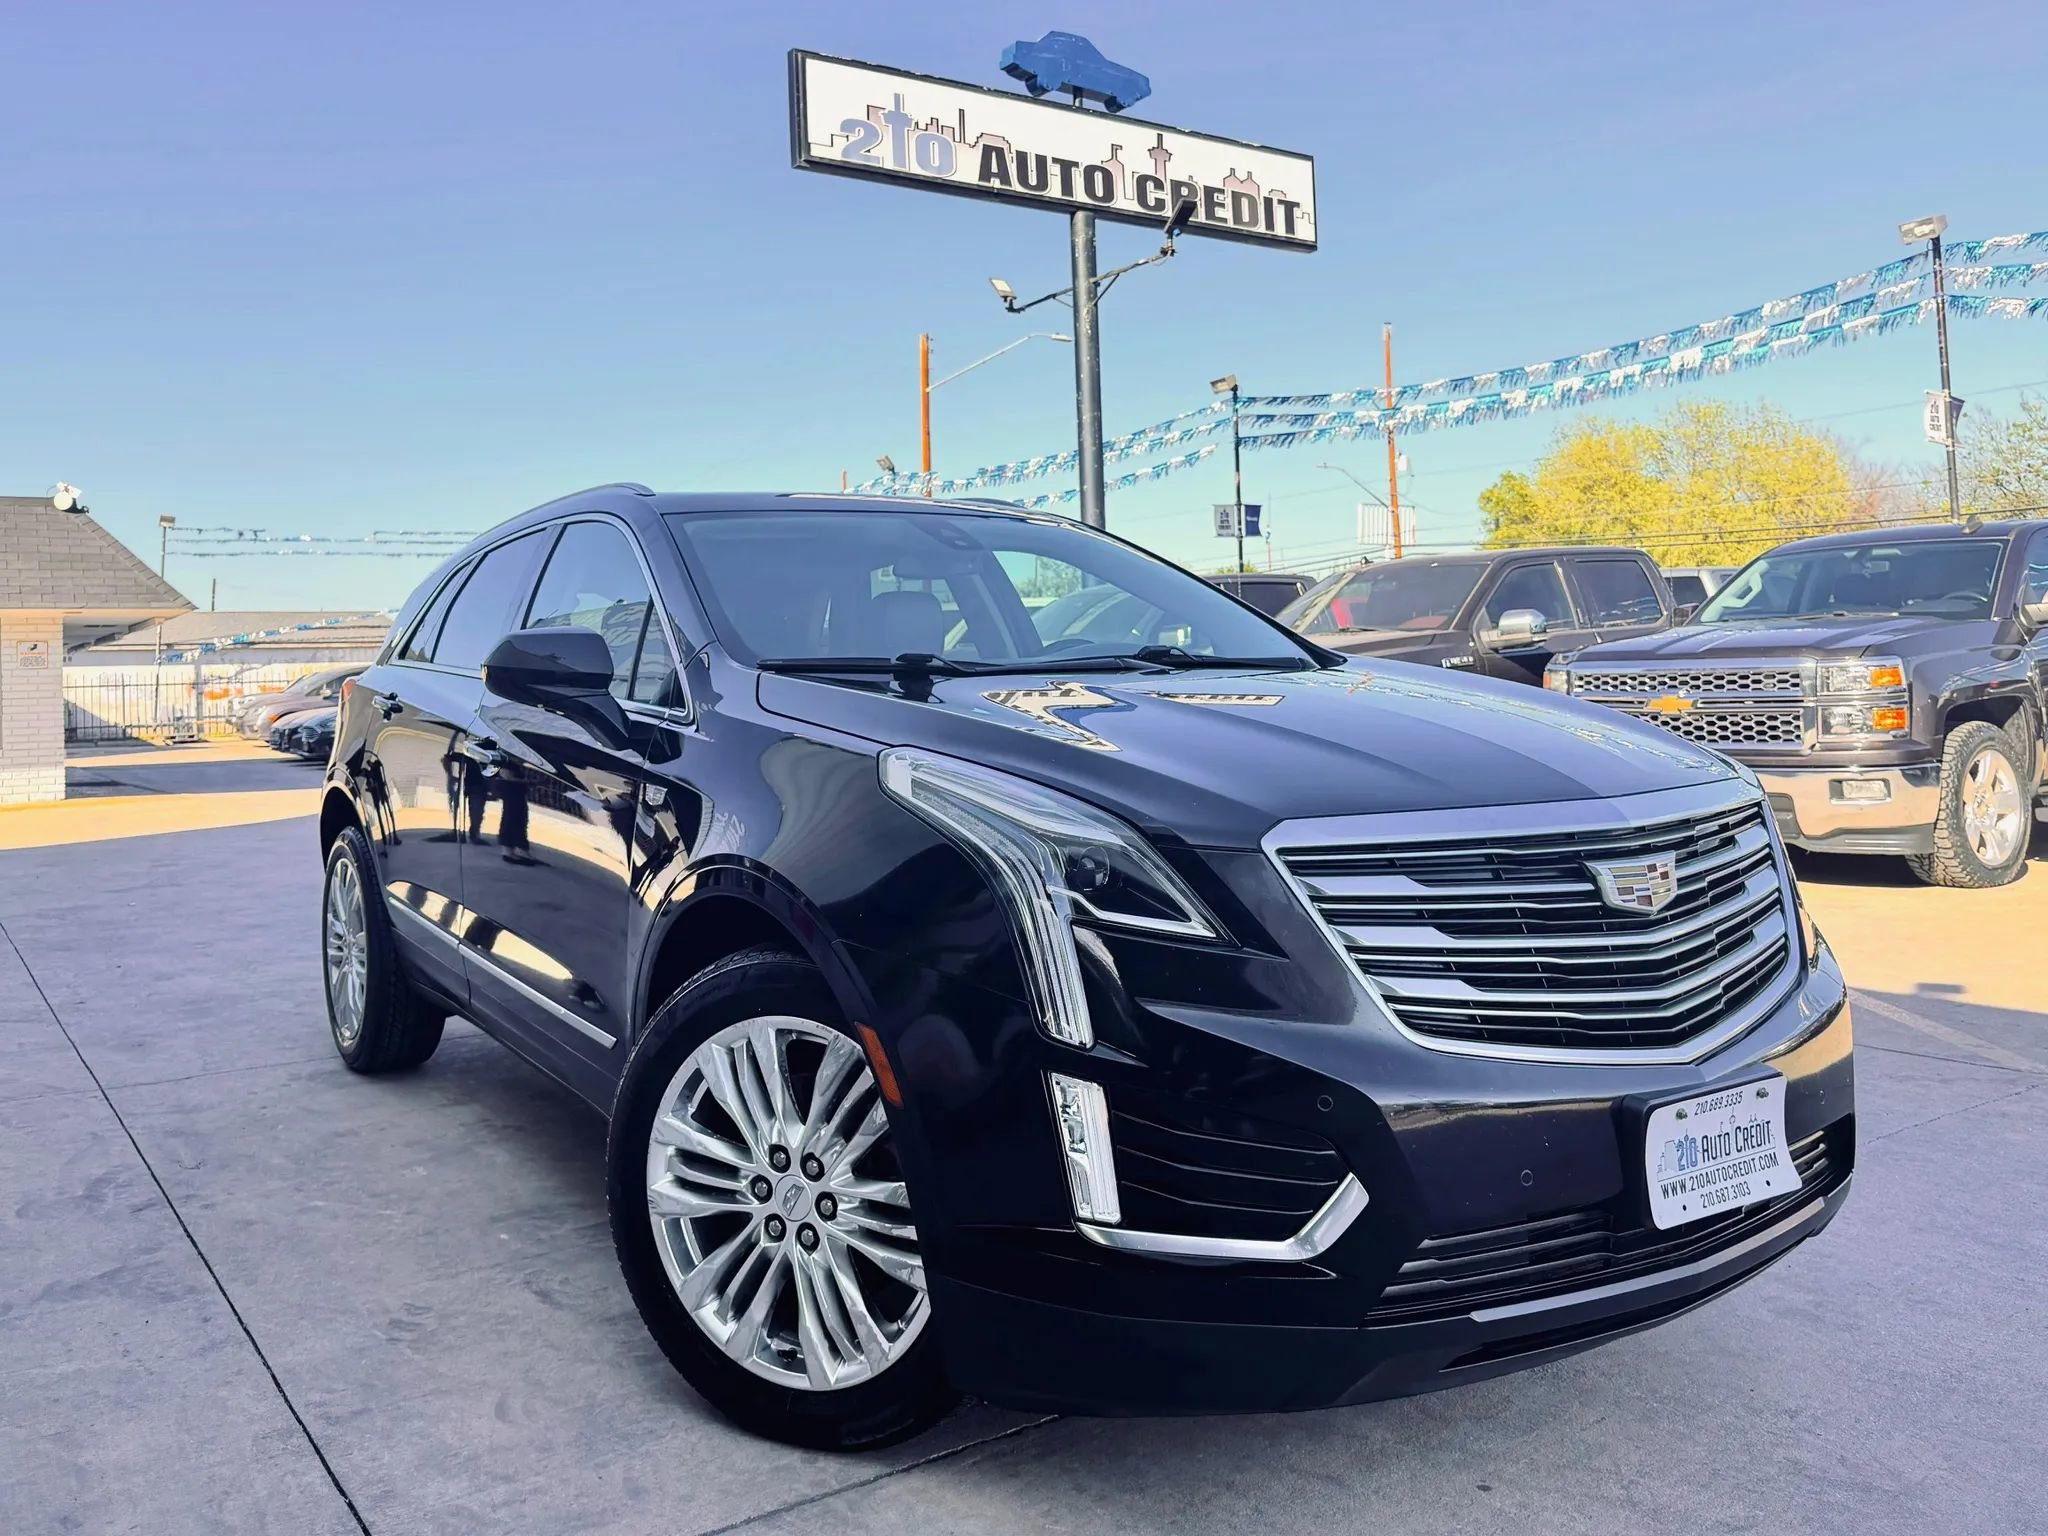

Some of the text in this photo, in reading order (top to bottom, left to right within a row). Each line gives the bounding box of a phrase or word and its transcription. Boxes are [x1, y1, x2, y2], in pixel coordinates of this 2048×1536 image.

[840, 93, 1300, 235] 210 AUTO CREDIT
[1694, 1091, 1743, 1116] 210.689.3335
[1677, 1133, 1699, 1172] 210
[1660, 1152, 1779, 1199] WWW.210AUTOCREDIT.COM
[1701, 1182, 1751, 1209] 210.687.3103
